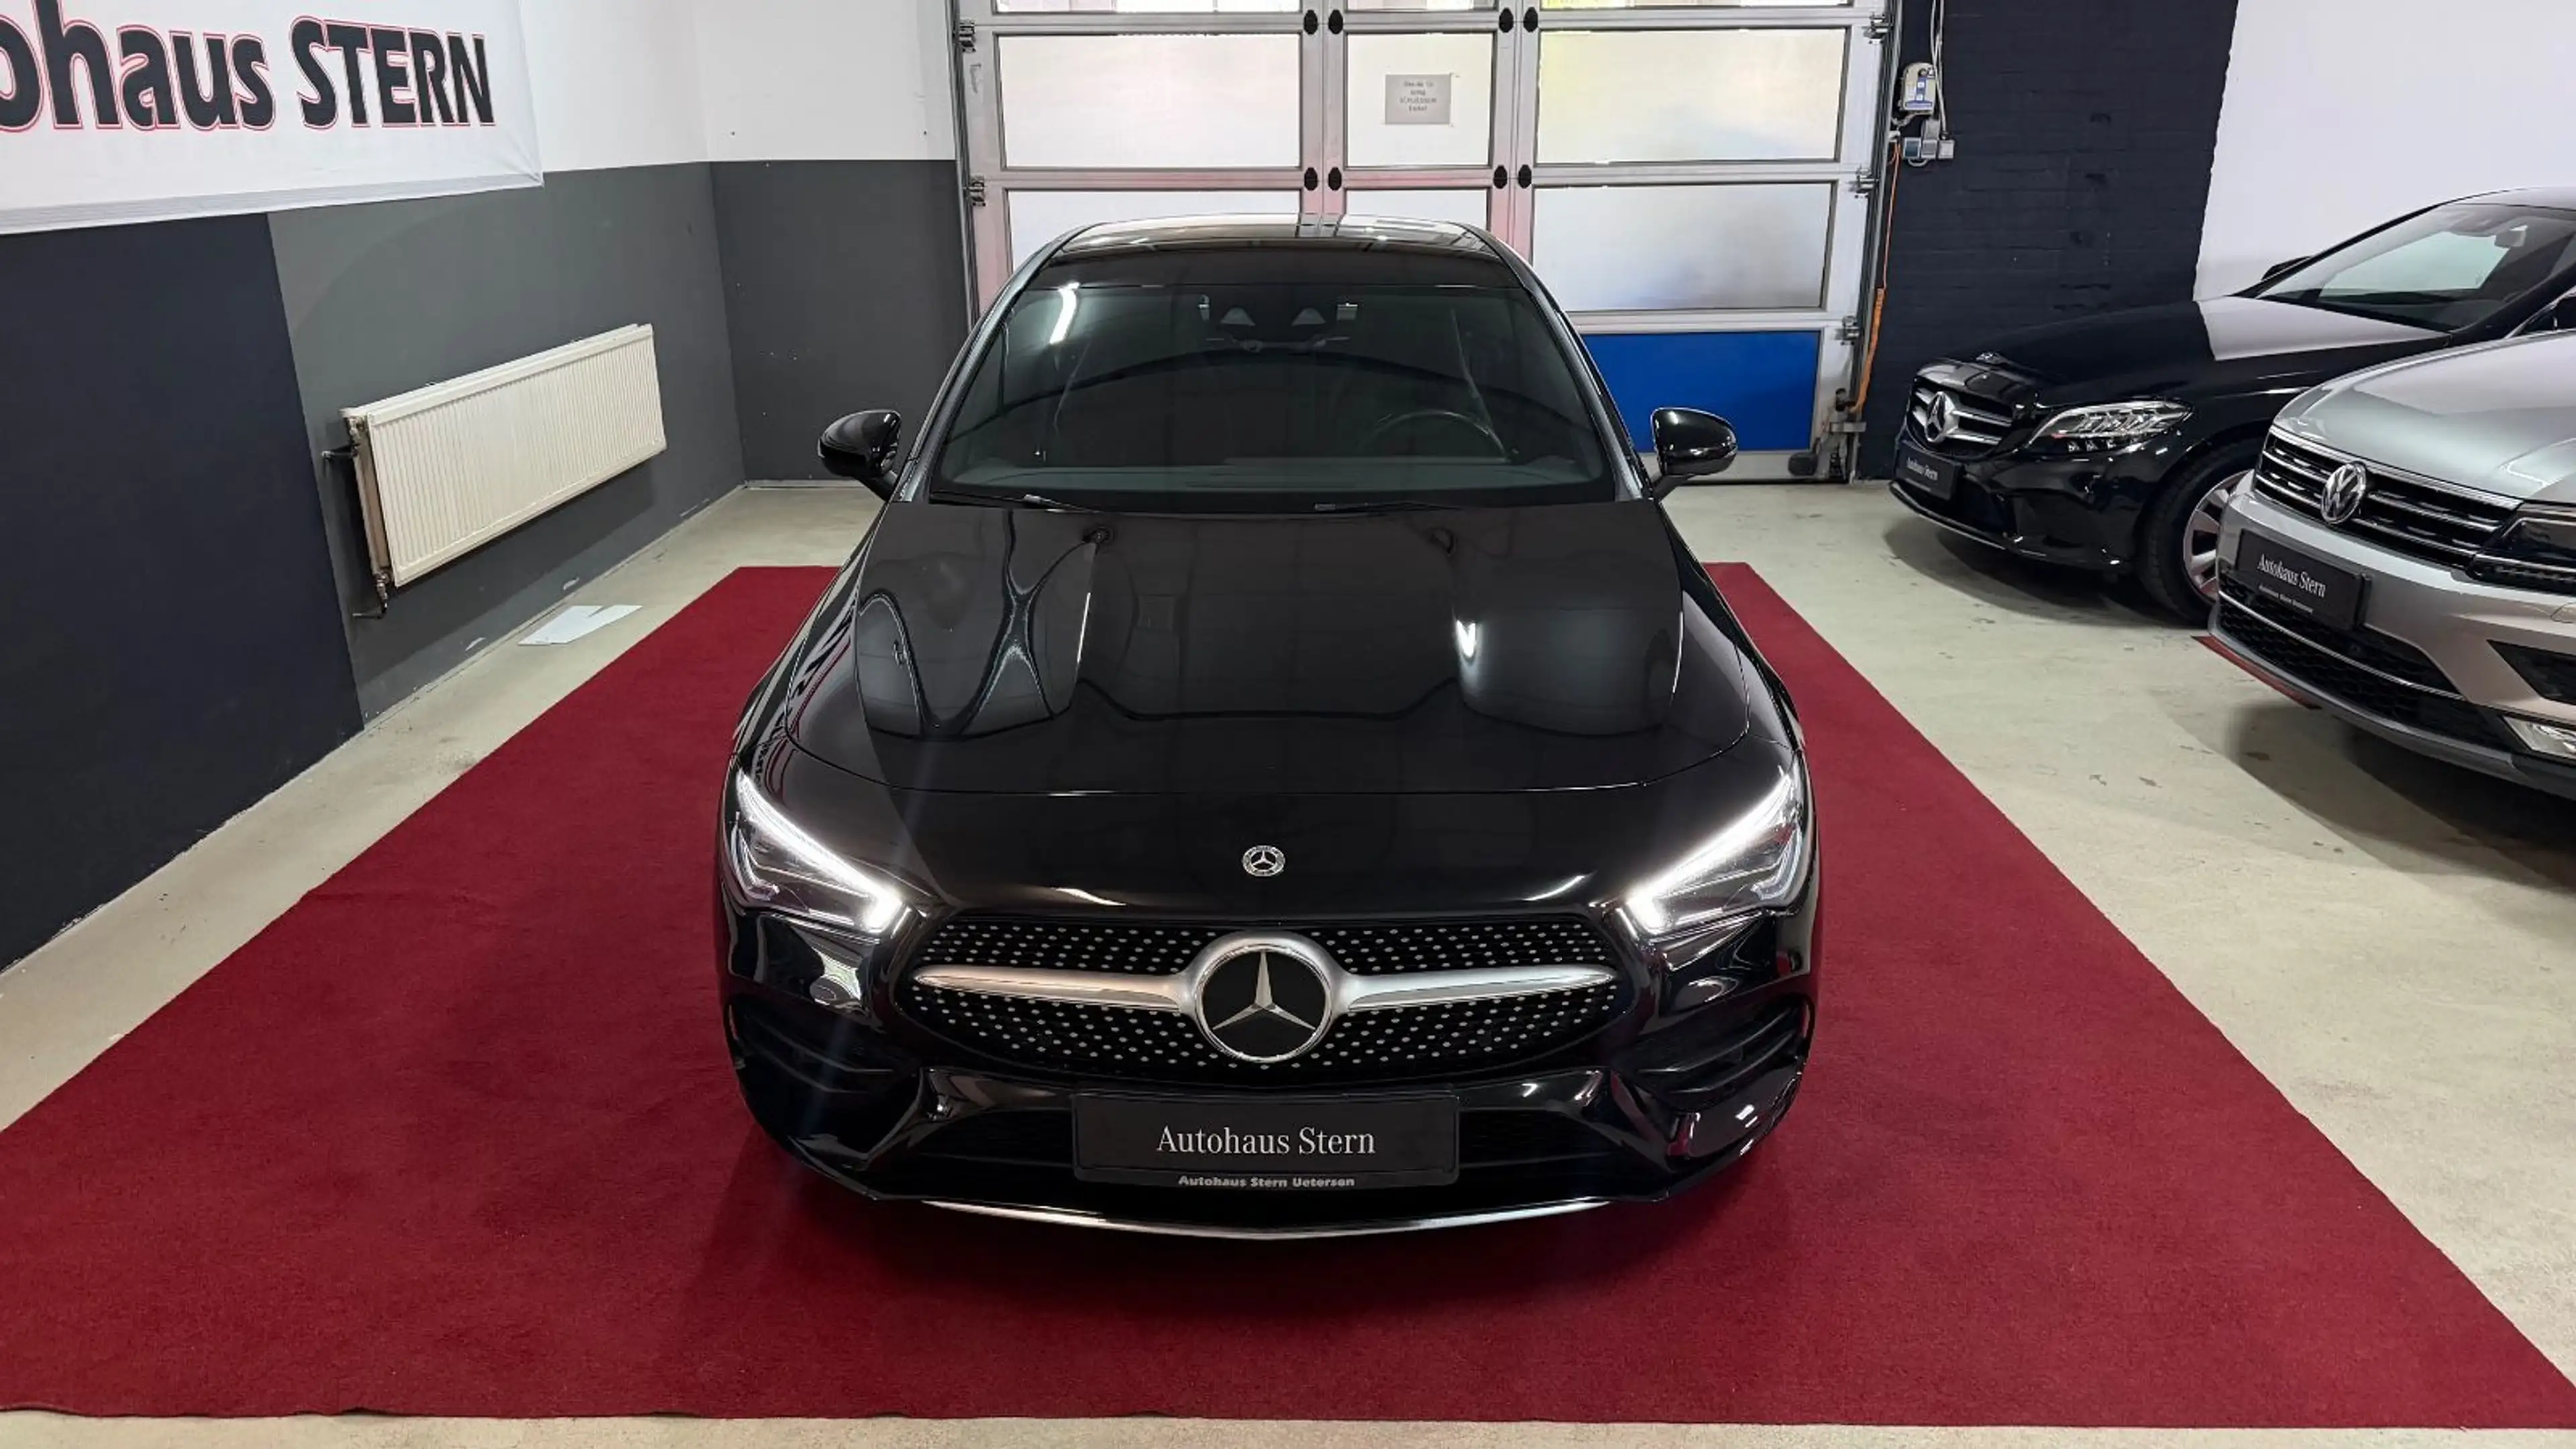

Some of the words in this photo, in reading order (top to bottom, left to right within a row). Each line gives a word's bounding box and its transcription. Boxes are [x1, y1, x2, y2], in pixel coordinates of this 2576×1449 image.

[289, 15, 496, 130] STERN
[2256, 553, 2300, 586] Autohaus
[2299, 571, 2326, 598] Stern
[1156, 1126, 1290, 1155] Autohaus
[1298, 1126, 1376, 1155] Stern
[1178, 1175, 1246, 1187] Autohaus
[1250, 1177, 1287, 1188] Stern
